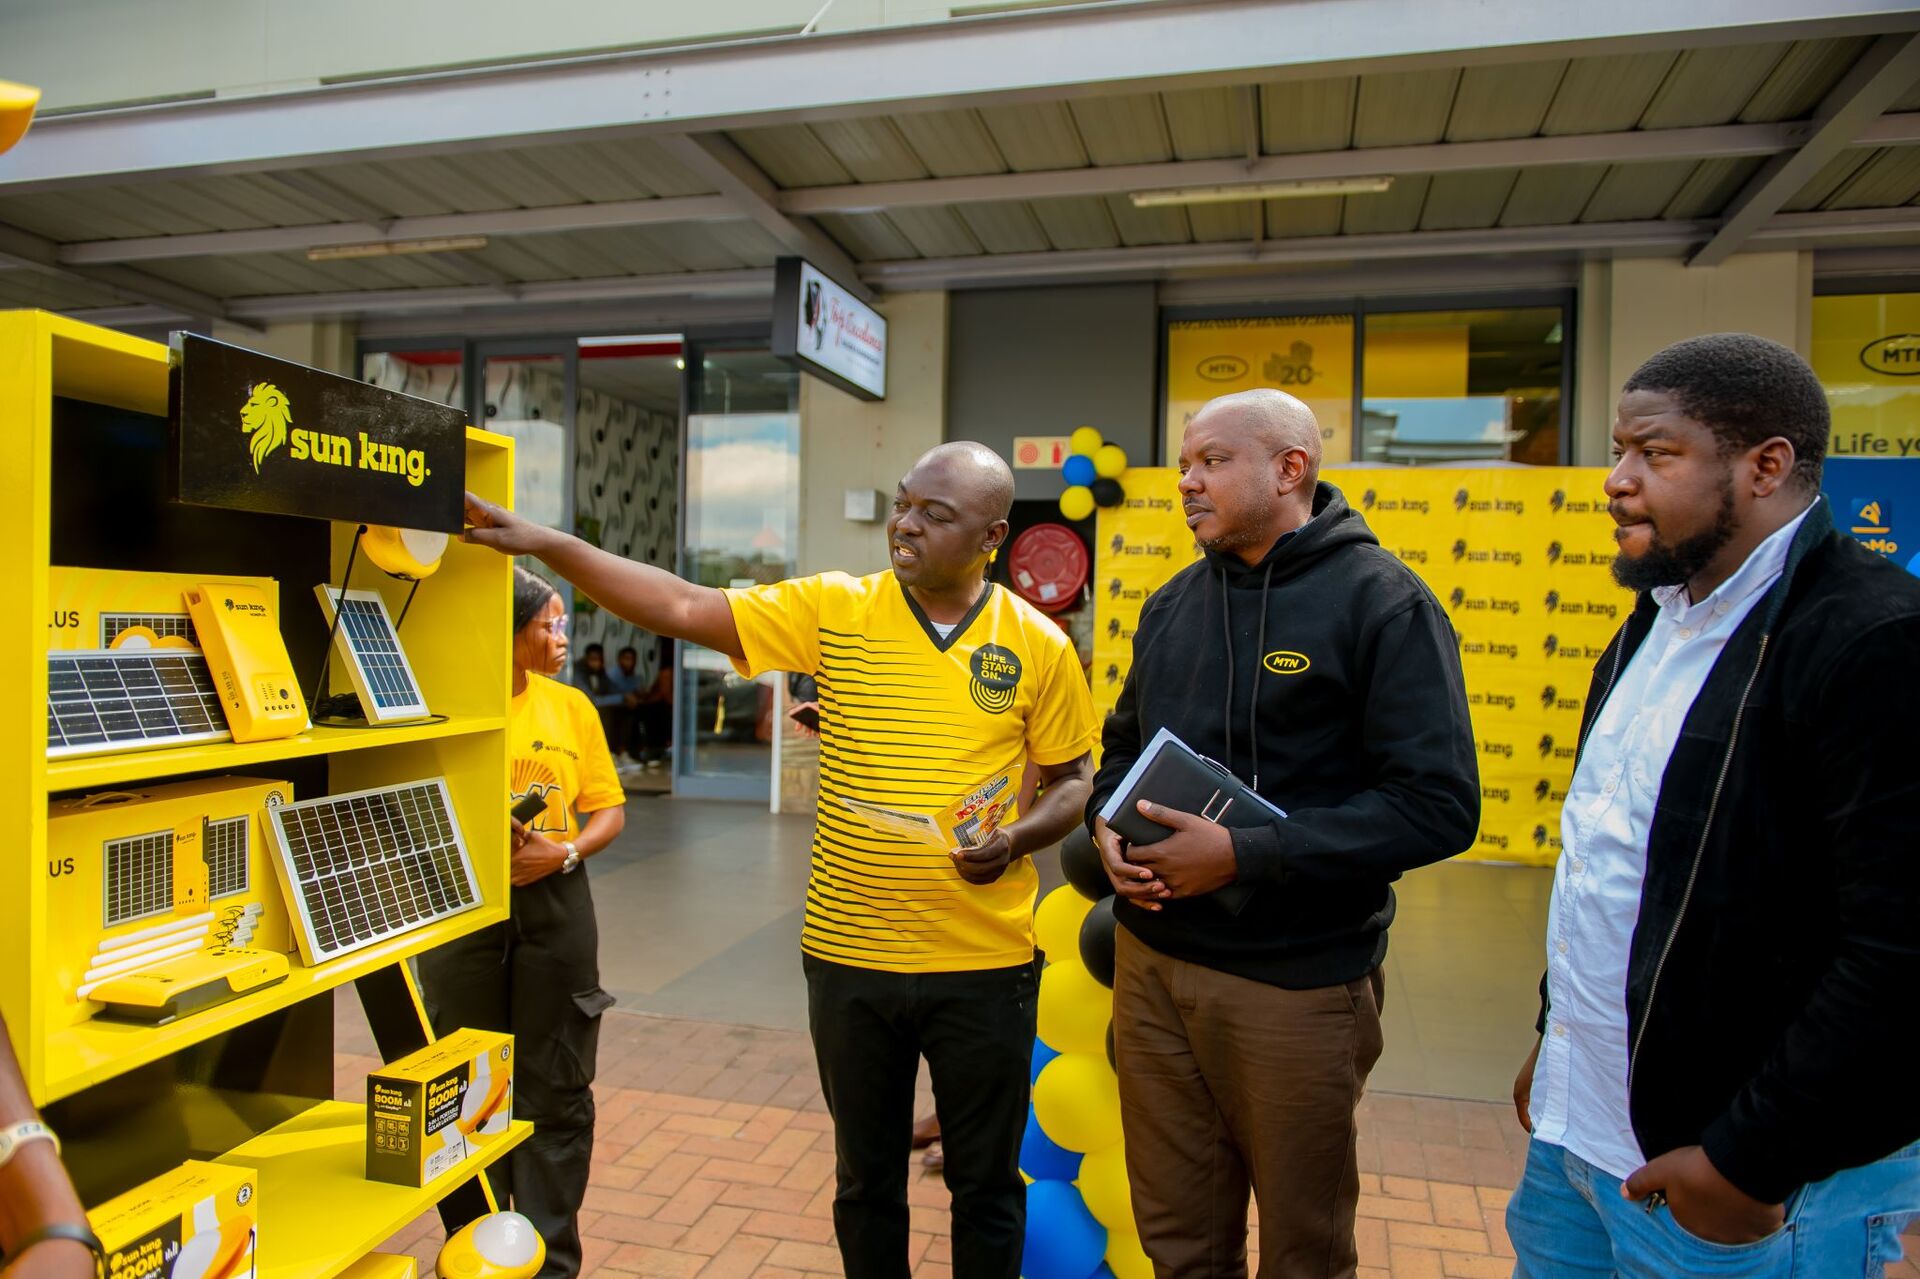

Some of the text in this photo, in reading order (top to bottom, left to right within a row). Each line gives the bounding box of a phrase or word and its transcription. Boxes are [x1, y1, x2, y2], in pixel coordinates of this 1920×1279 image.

[1209, 363, 1236, 373] MTN
[1834, 433, 1888, 454] Life
[290, 428, 432, 487] sun king.
[48, 611, 80, 628] US
[982, 652, 1006, 664] LIFE
[1273, 656, 1299, 668] MTN
[981, 660, 1016, 675] STAYS
[981, 670, 1002, 682] ON.
[271, 797, 278, 807] 3
[375, 1094, 403, 1106] BOOM
[428, 1085, 459, 1110] BOOM
[241, 1188, 248, 1198] 2
[122, 1249, 140, 1266] sun
